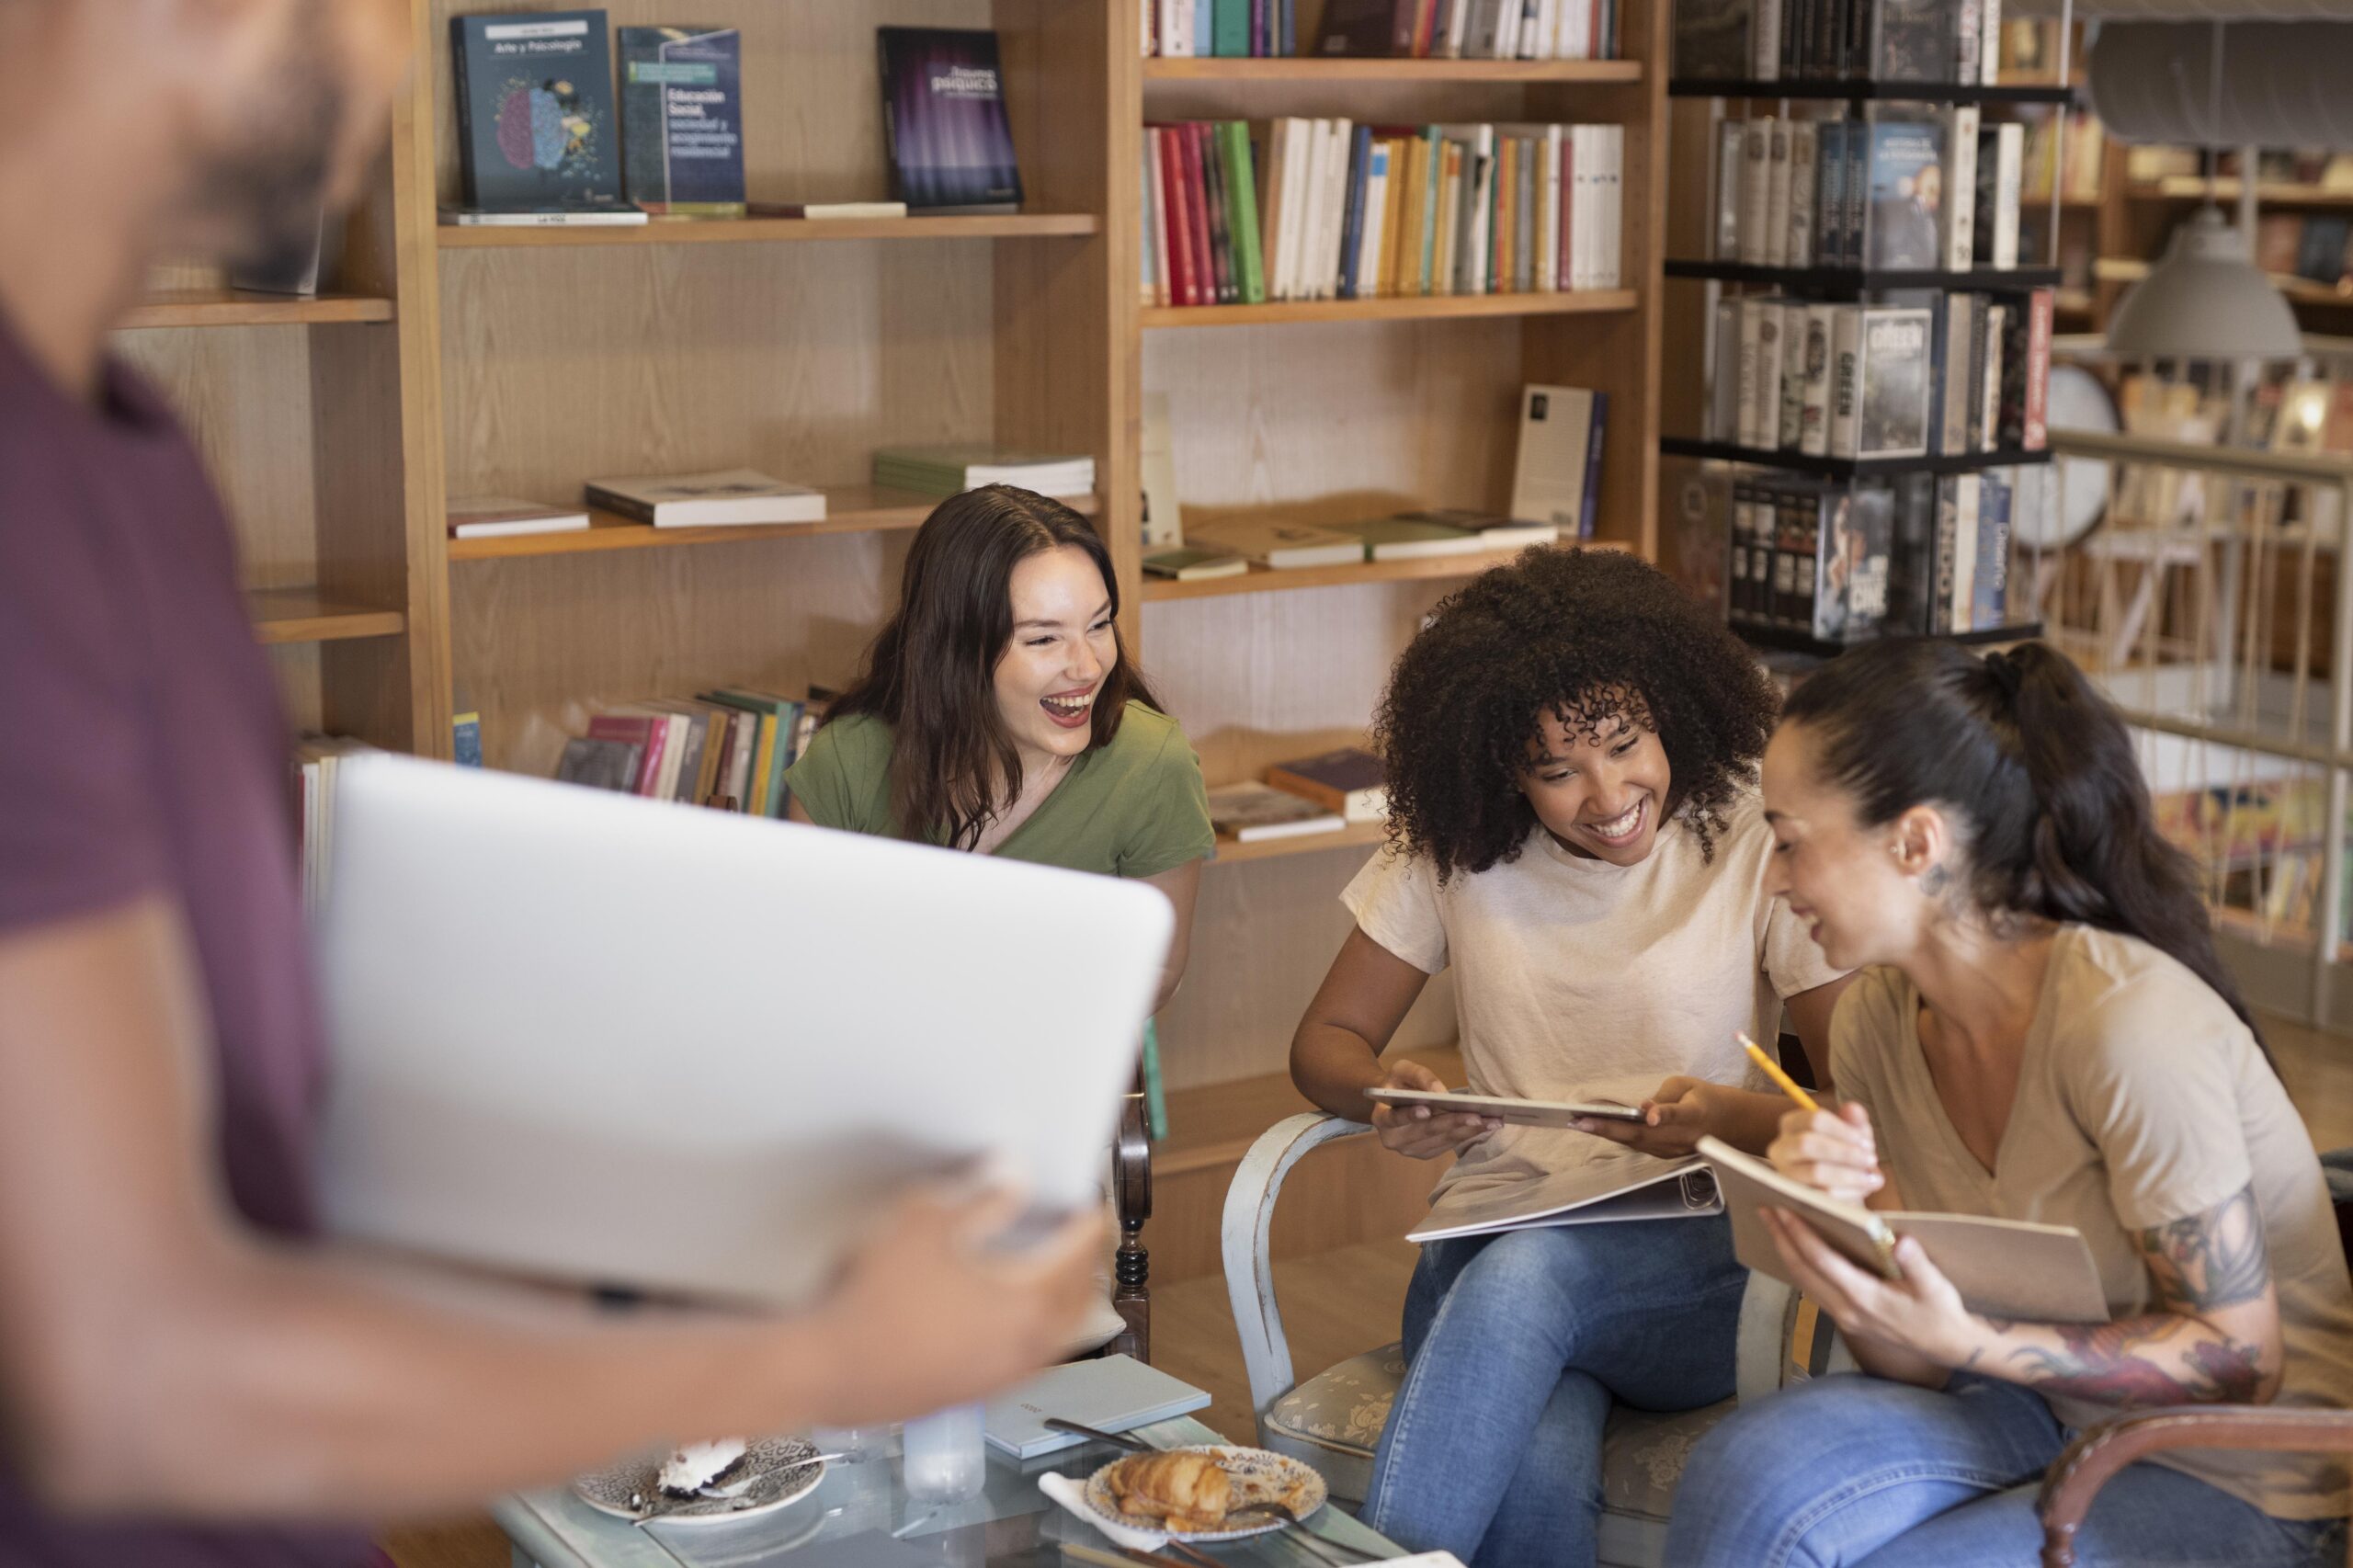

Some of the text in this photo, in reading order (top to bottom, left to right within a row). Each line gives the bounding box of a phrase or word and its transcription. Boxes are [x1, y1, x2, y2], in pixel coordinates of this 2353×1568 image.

[494, 43, 517, 53] Arte
[667, 87, 726, 103] Educación
[1838, 351, 1855, 416] GREEN
